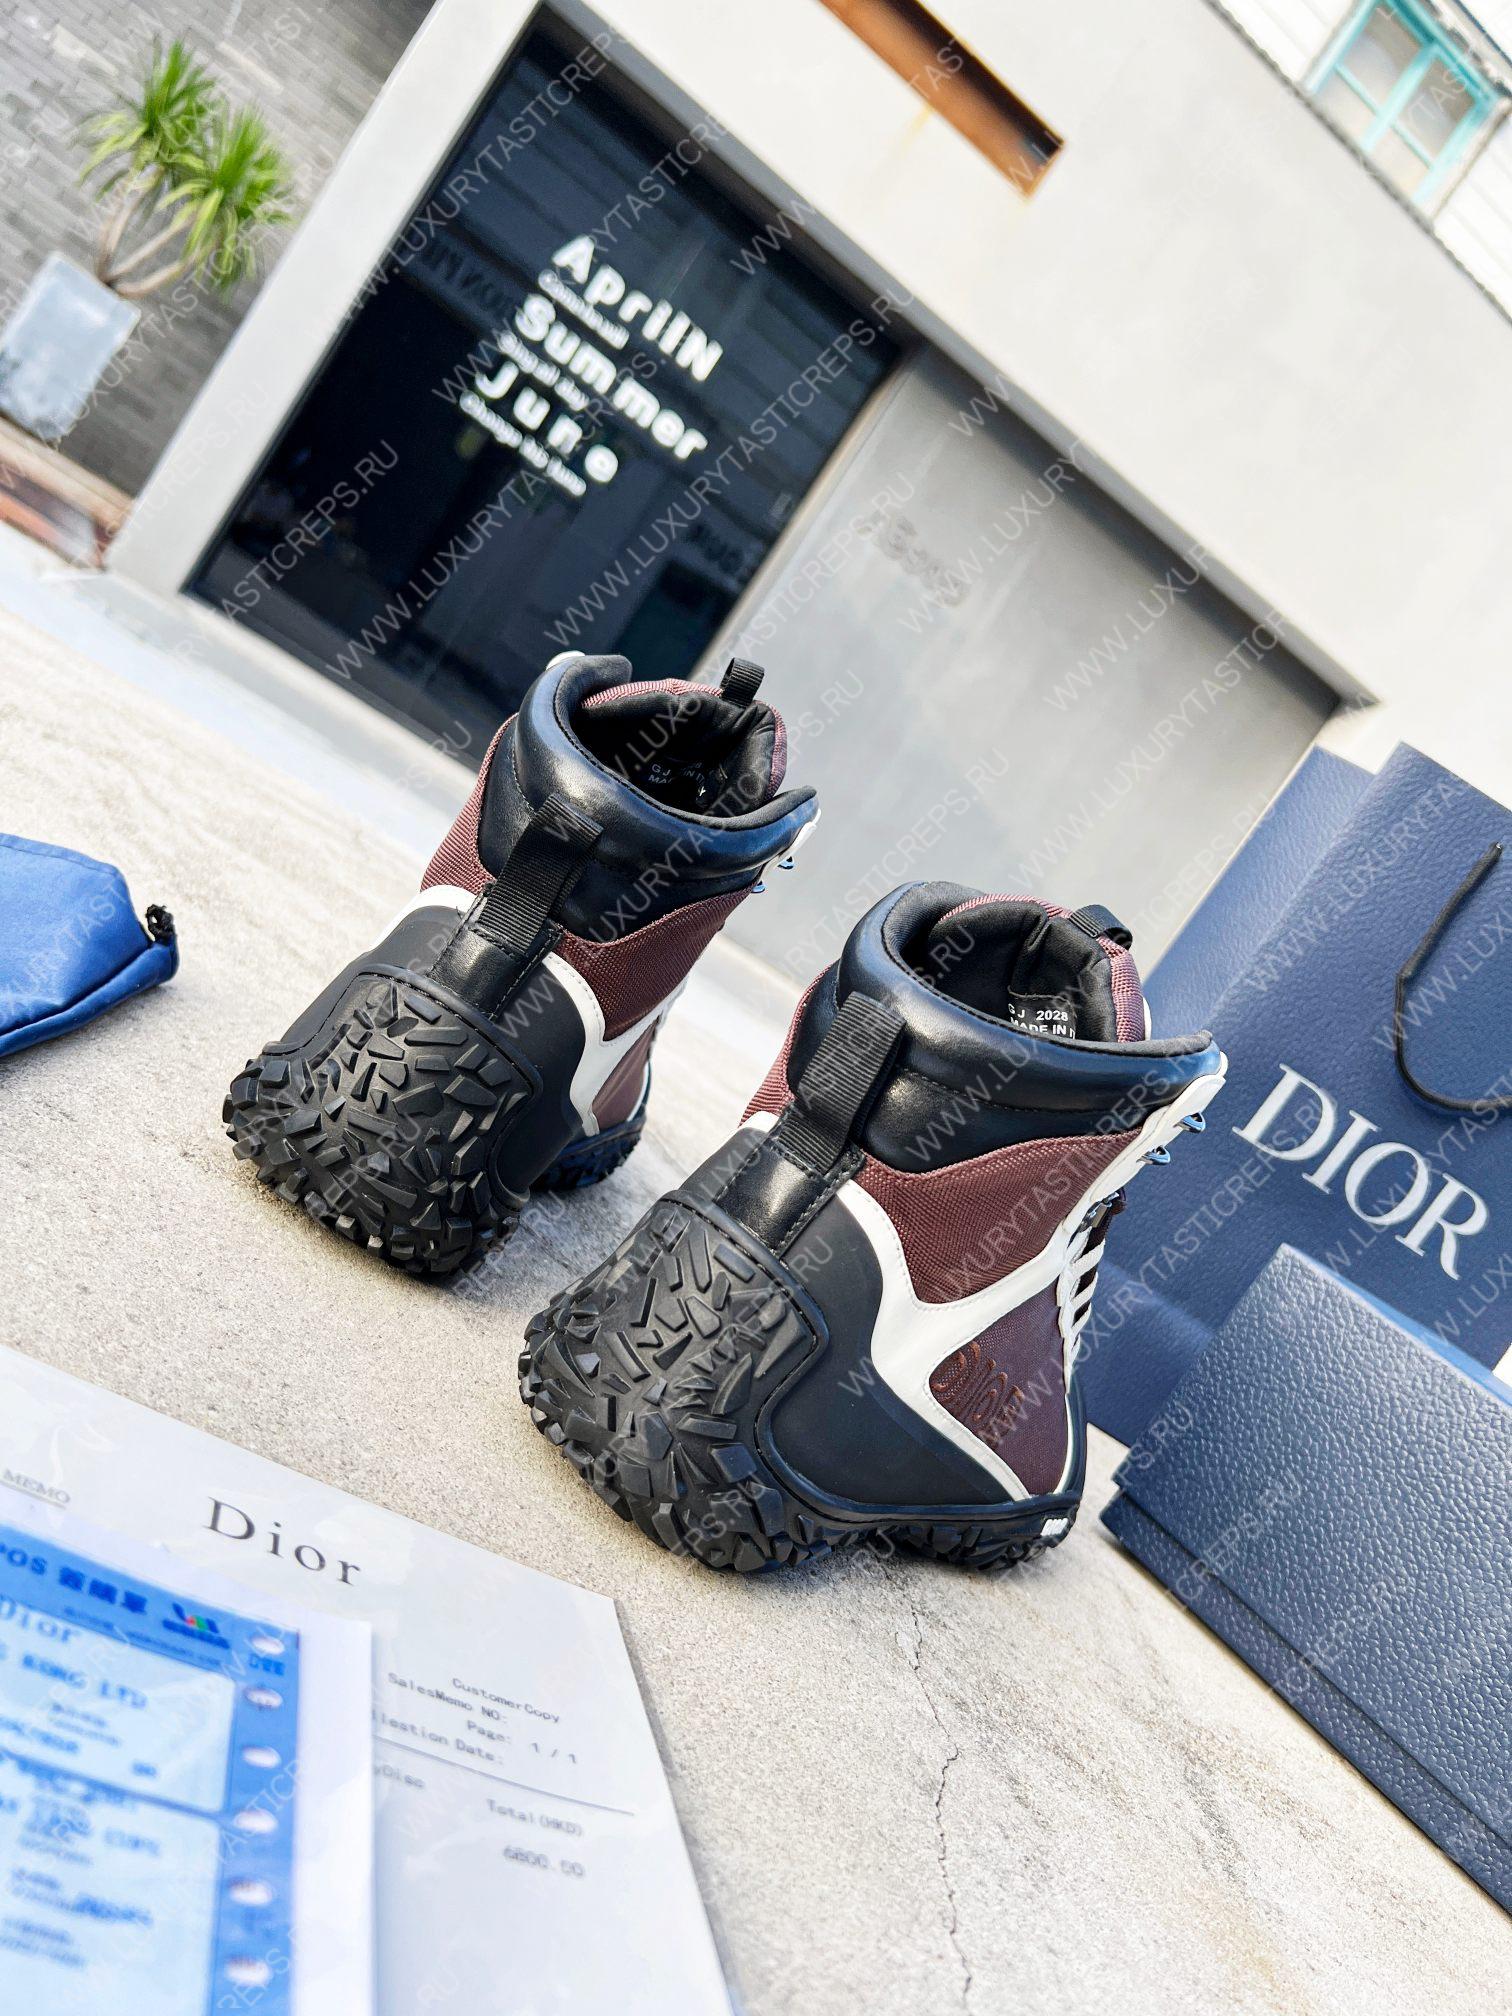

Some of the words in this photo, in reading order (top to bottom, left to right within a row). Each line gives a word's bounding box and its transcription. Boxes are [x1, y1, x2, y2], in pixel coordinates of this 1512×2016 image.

[1036, 1009, 1069, 1022] 2028
[1052, 1024, 1067, 1036] IN
[1232, 1063, 1489, 1281] DIOR
[203, 1496, 361, 1586] Dior
